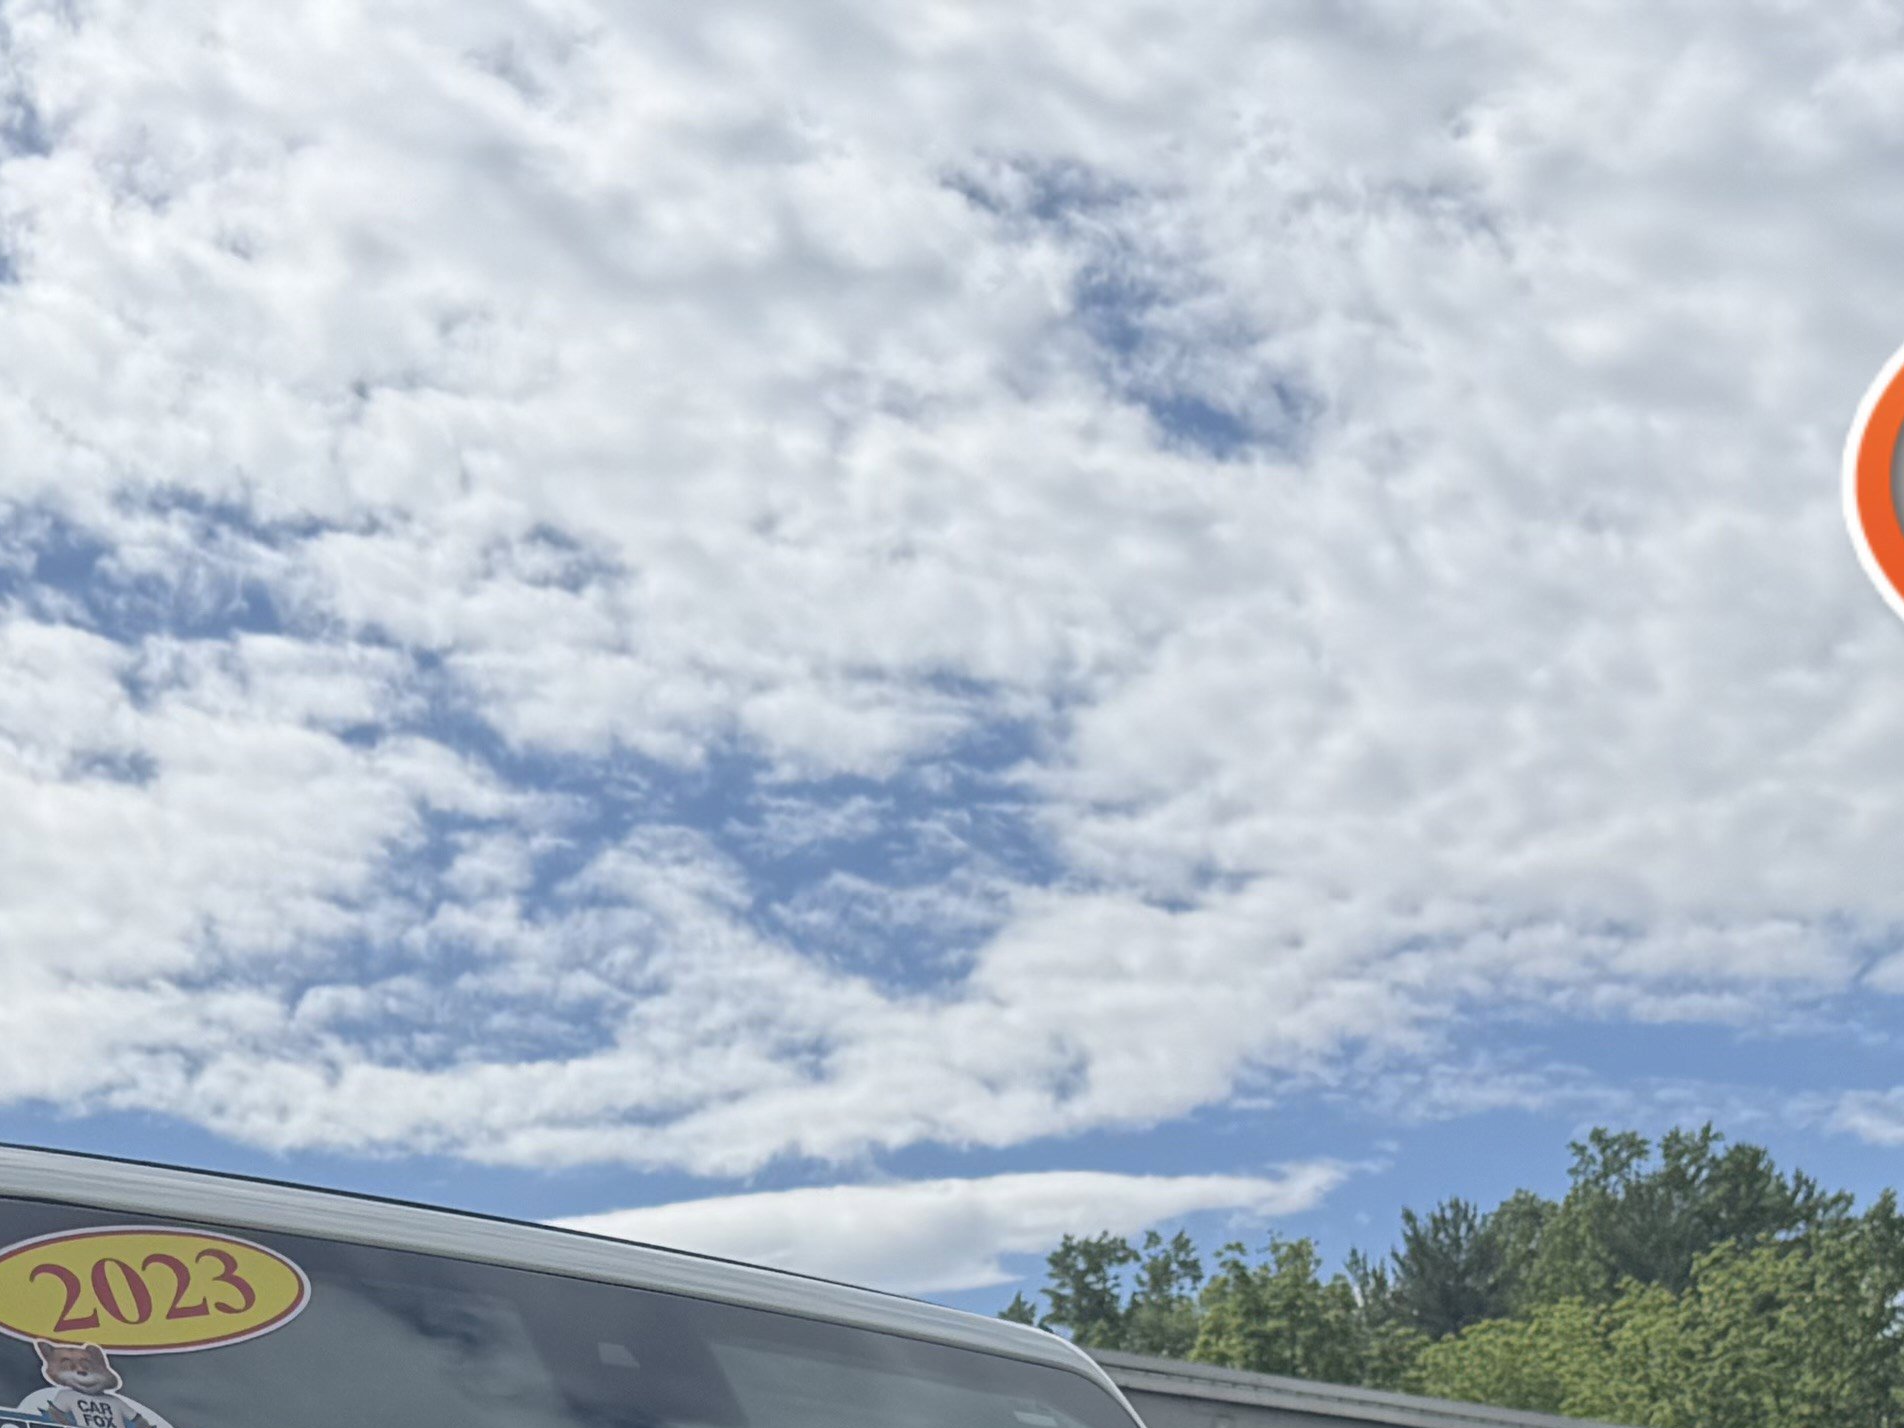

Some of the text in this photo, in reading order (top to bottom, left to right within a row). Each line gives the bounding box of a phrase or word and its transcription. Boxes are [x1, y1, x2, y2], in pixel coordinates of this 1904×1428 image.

[29, 1248, 256, 1333] 2023
[77, 1399, 113, 1416] CAR
[83, 1413, 117, 1428] FOX
